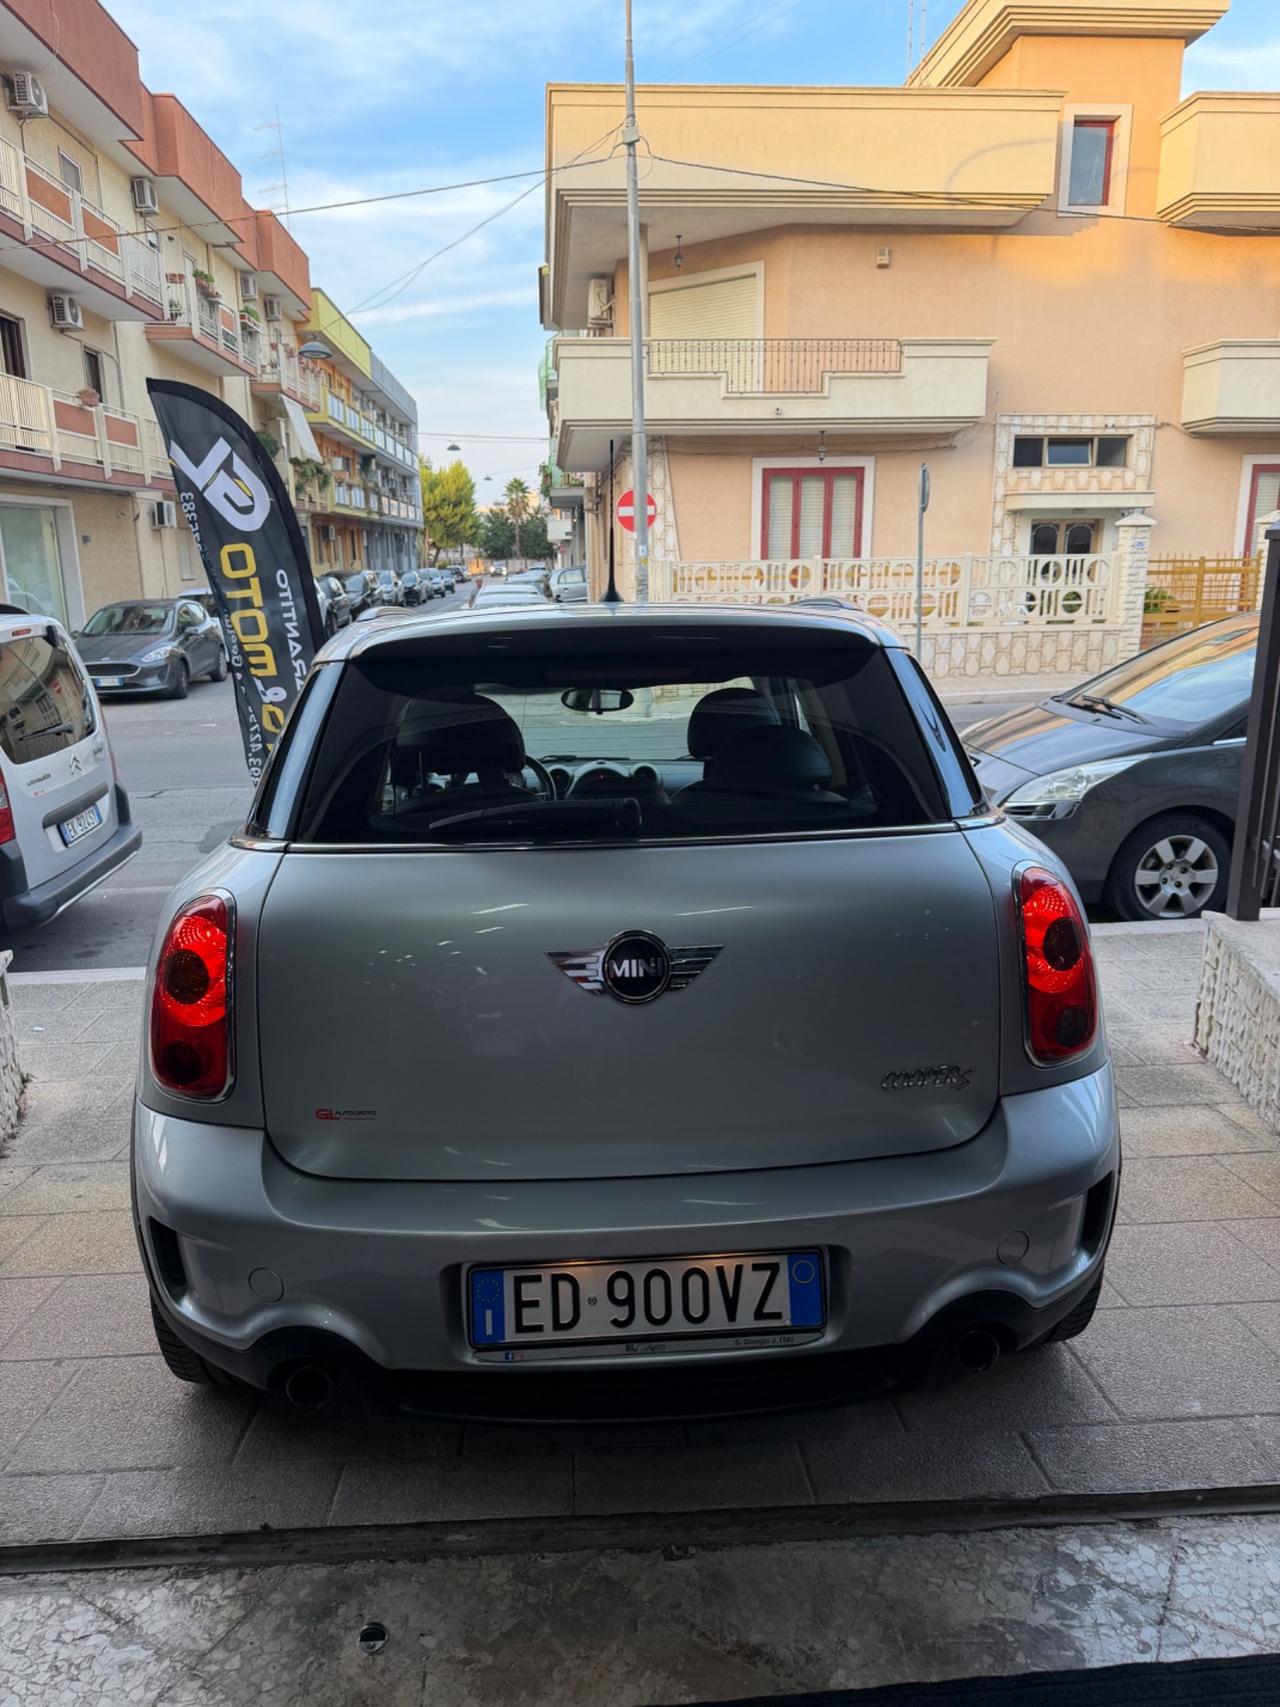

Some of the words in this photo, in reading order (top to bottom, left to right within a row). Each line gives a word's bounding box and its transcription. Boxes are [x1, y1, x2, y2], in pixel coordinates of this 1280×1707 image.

[608, 957, 664, 978] MINI
[513, 1273, 581, 1334] ED
[606, 1262, 783, 1328] 900VZ
